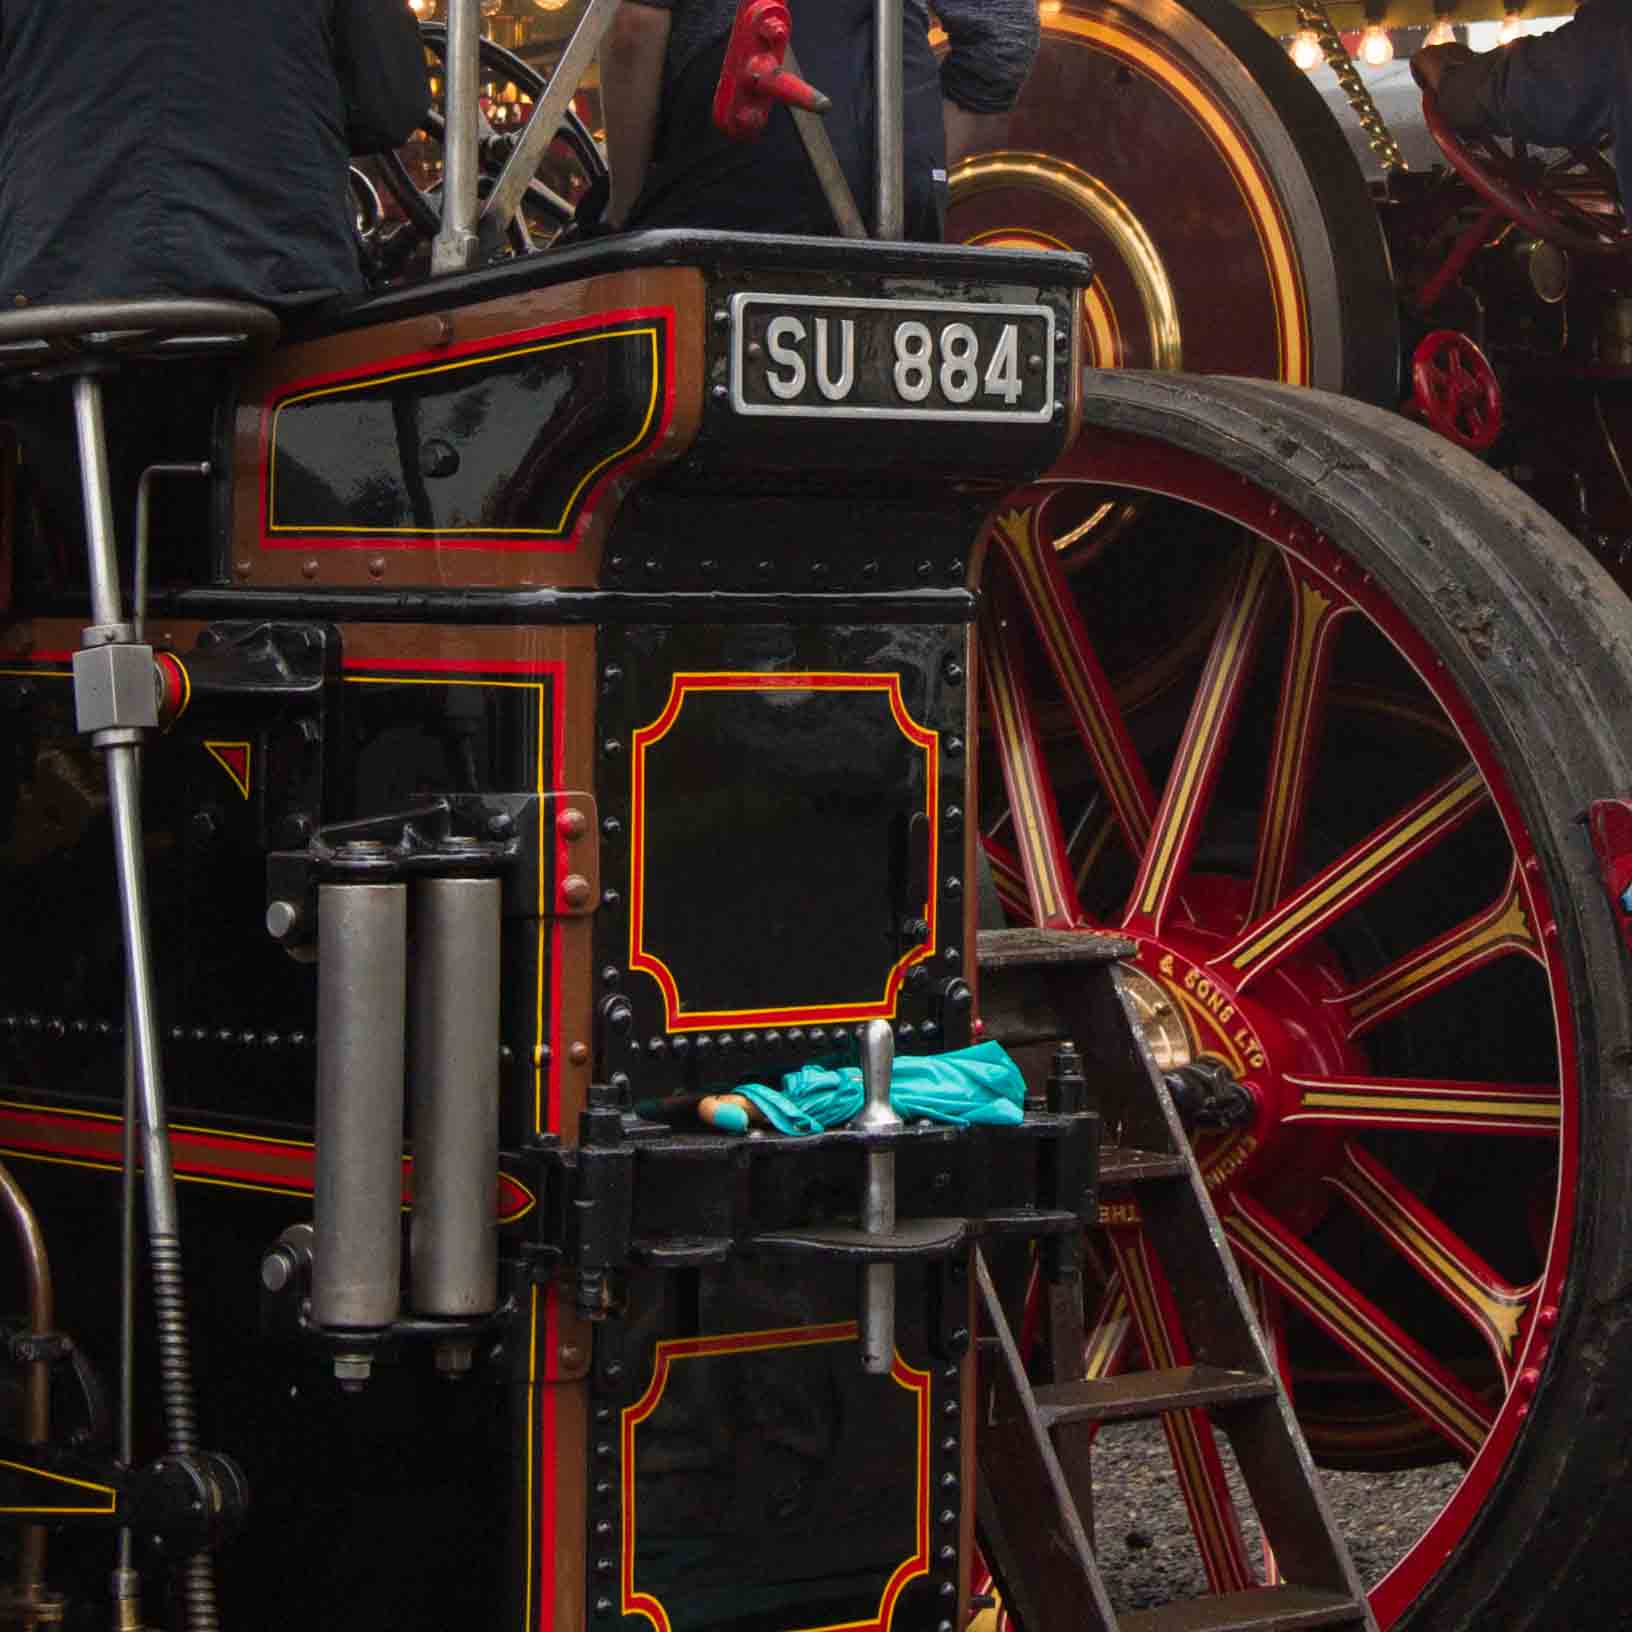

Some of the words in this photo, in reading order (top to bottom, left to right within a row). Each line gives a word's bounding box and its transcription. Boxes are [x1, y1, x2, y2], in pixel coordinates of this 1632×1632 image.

[766, 316, 855, 401] SU
[893, 320, 1023, 405] 884
[1184, 970, 1236, 1024] SONS
